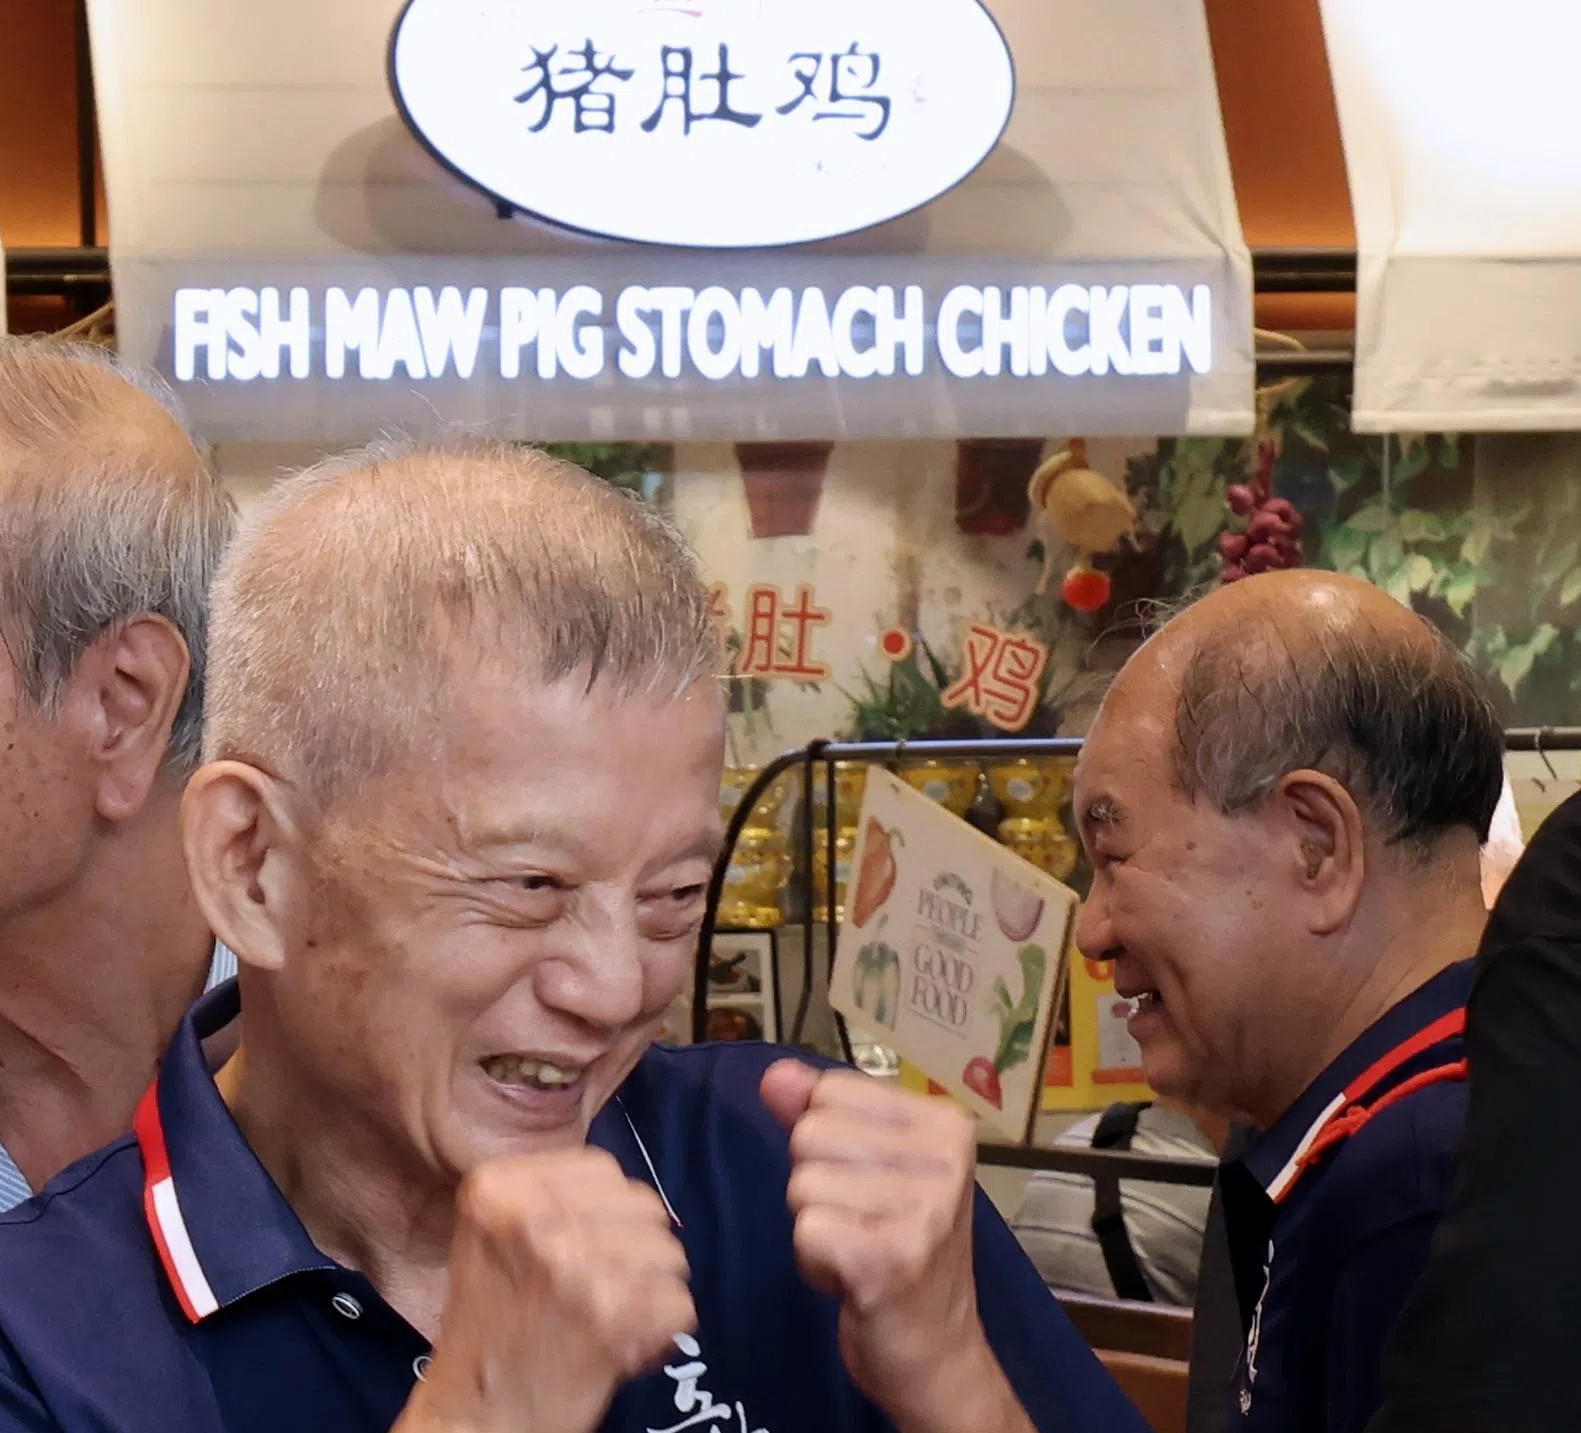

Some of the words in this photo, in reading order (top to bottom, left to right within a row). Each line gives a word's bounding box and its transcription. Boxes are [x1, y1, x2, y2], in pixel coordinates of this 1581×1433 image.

[513, 37, 891, 140] 猪肚鸡
[173, 286, 311, 381] FISH
[324, 286, 488, 380] MAW
[497, 286, 604, 381] PIG
[617, 285, 922, 380] STOMACH
[936, 284, 1213, 376] CHICKEN
[911, 975, 968, 1027] FOOD
[914, 943, 974, 993] GOOD
